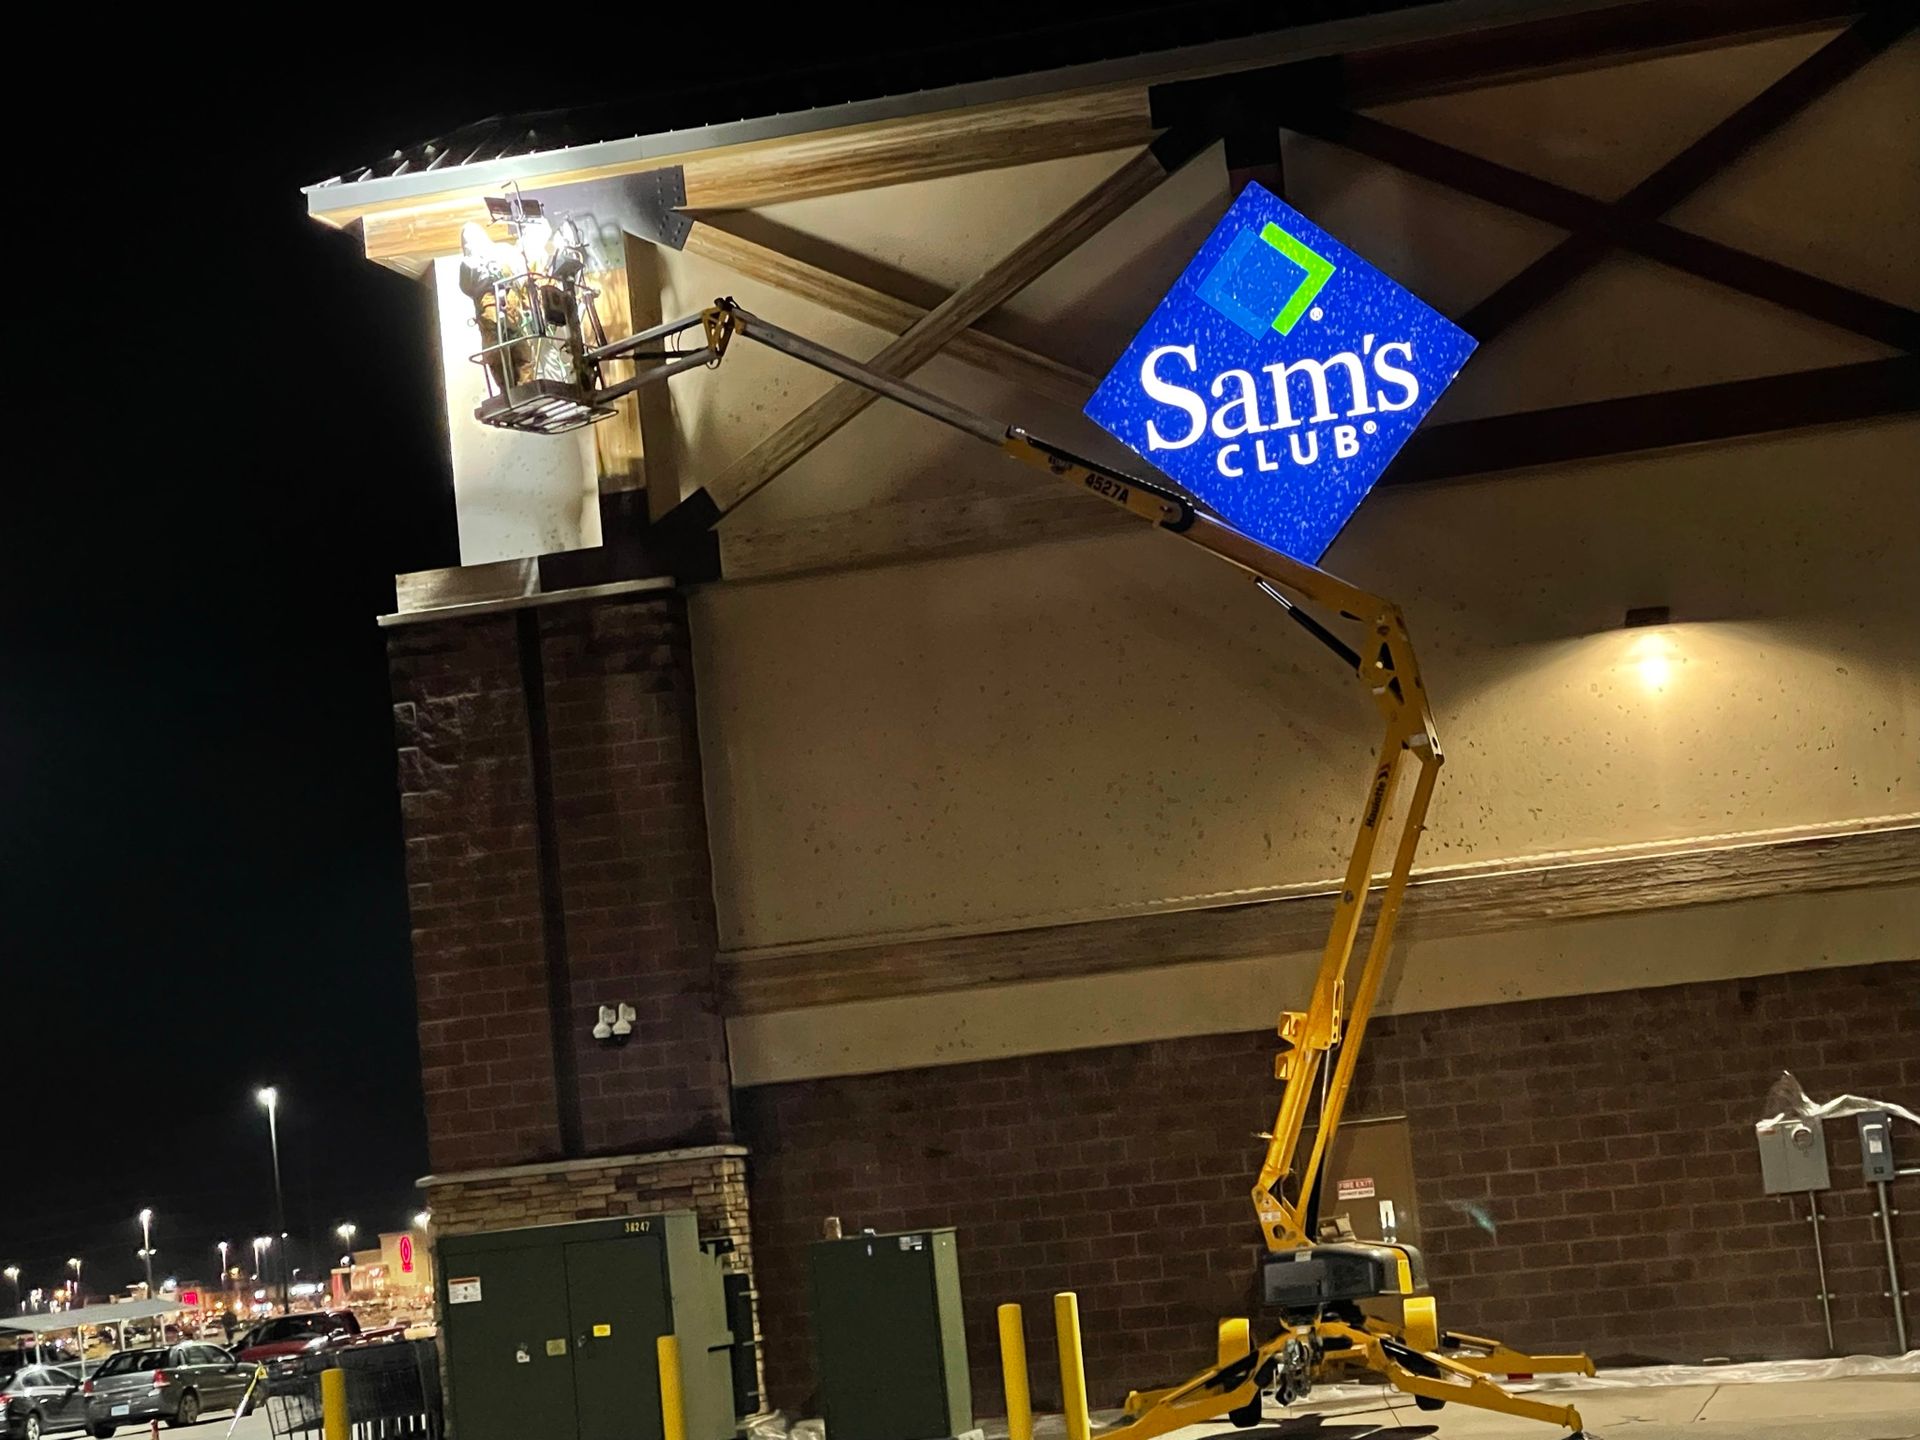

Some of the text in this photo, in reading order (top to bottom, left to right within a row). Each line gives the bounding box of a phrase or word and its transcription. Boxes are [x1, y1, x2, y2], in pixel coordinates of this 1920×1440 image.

[1141, 333, 1419, 452] Sam's
[1216, 425, 1360, 478] CLUB
[1084, 472, 1130, 505] 4527A
